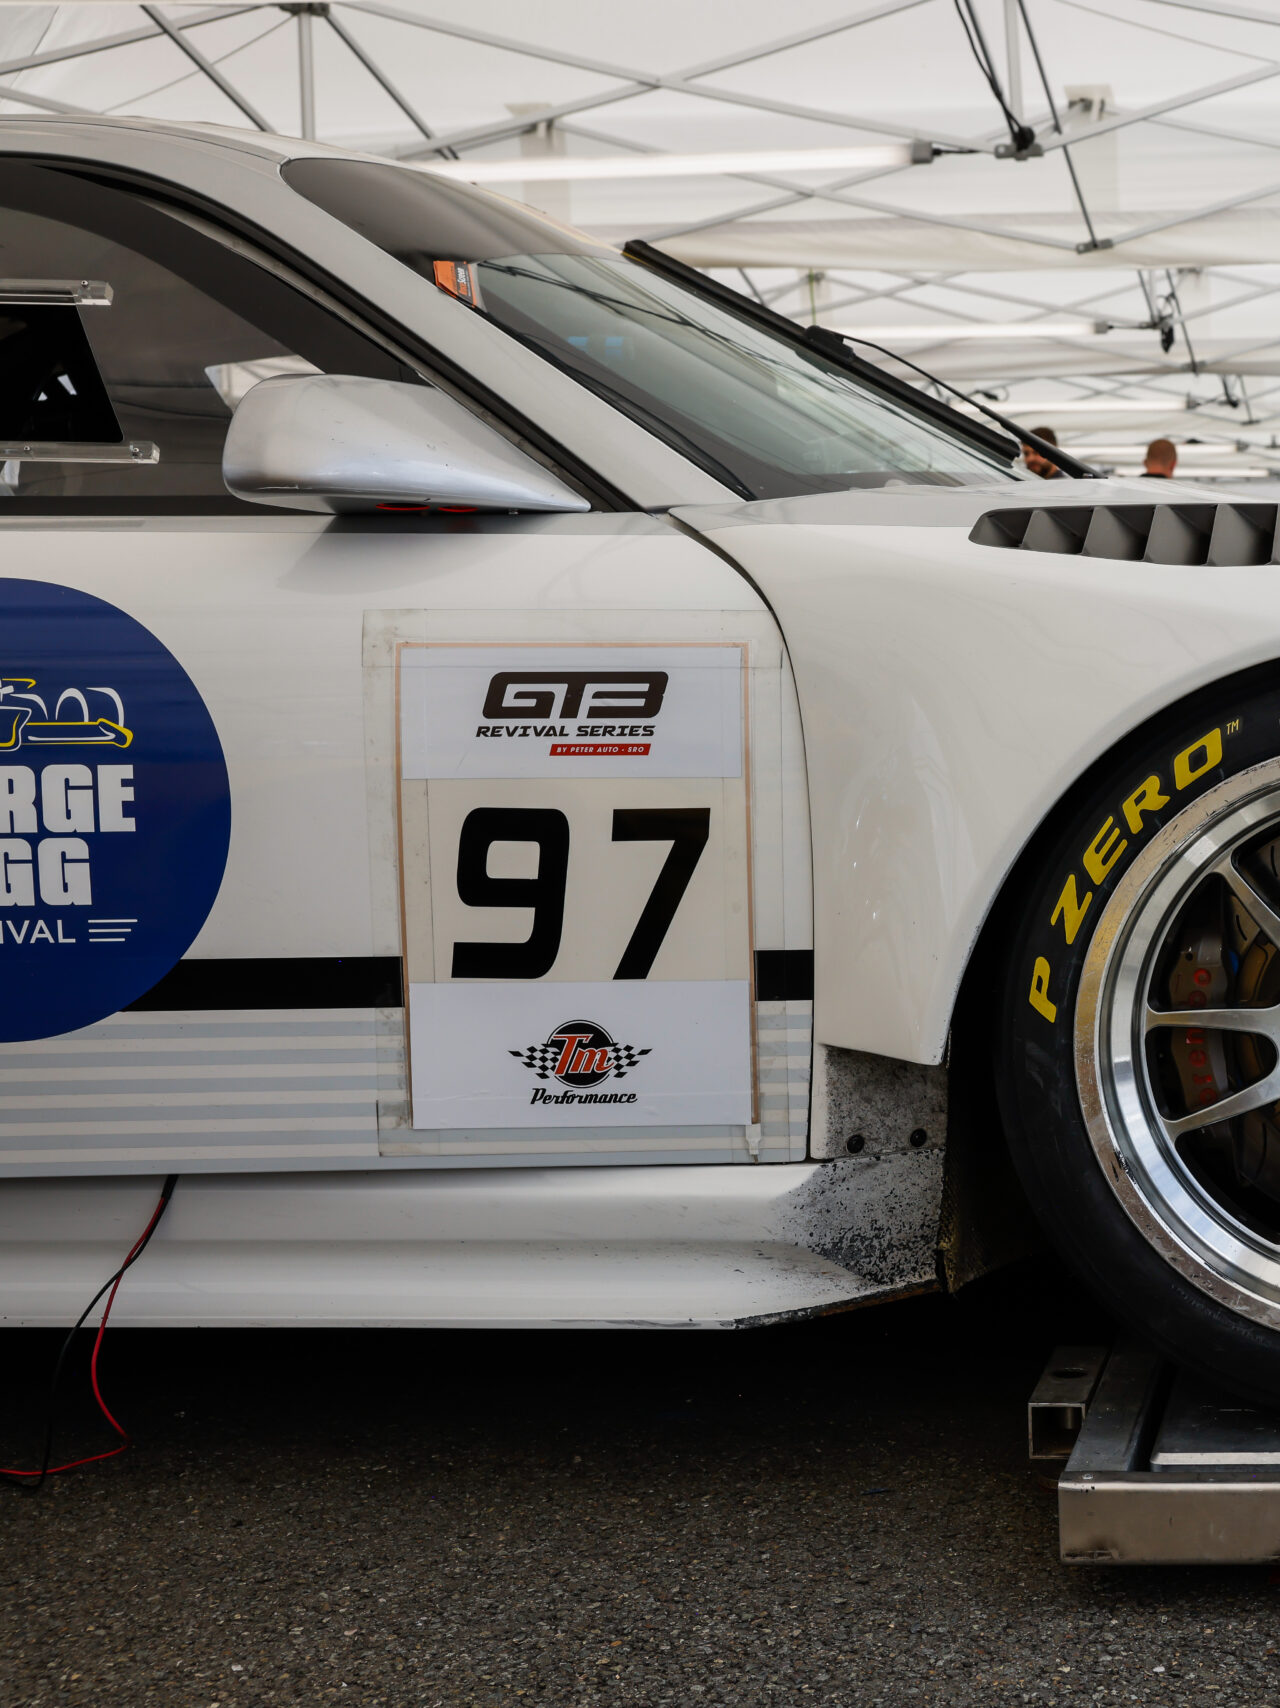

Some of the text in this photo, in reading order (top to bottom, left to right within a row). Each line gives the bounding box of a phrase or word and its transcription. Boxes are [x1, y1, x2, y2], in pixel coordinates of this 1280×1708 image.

[482, 671, 669, 719] GT3
[475, 725, 656, 738] REVIVAL SERIES
[0, 764, 137, 833] RGE
[451, 807, 711, 980] 97
[1029, 956, 1057, 1023] P
[1050, 728, 1222, 945] ZERO
[530, 1087, 638, 1105] Performance
